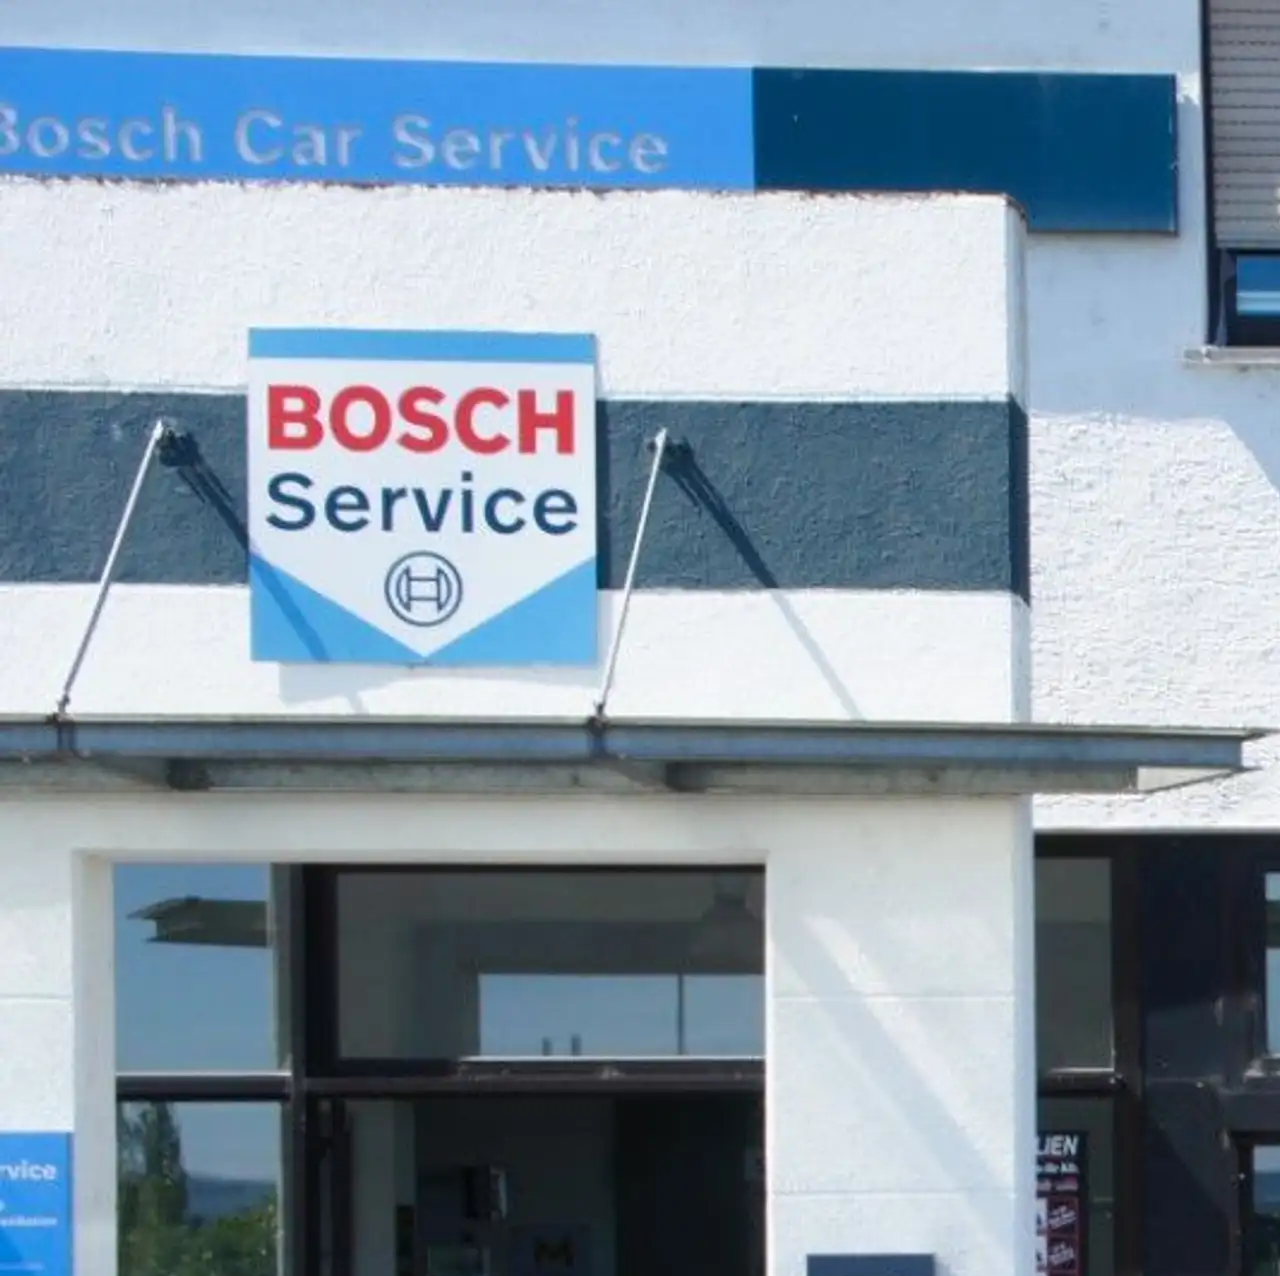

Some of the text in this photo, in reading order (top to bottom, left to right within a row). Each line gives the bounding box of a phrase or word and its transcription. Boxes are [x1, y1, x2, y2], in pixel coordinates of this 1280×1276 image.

[234, 108, 362, 167] Car
[392, 112, 669, 174] Service
[267, 384, 576, 455] BOSCH
[265, 470, 578, 536] Service
